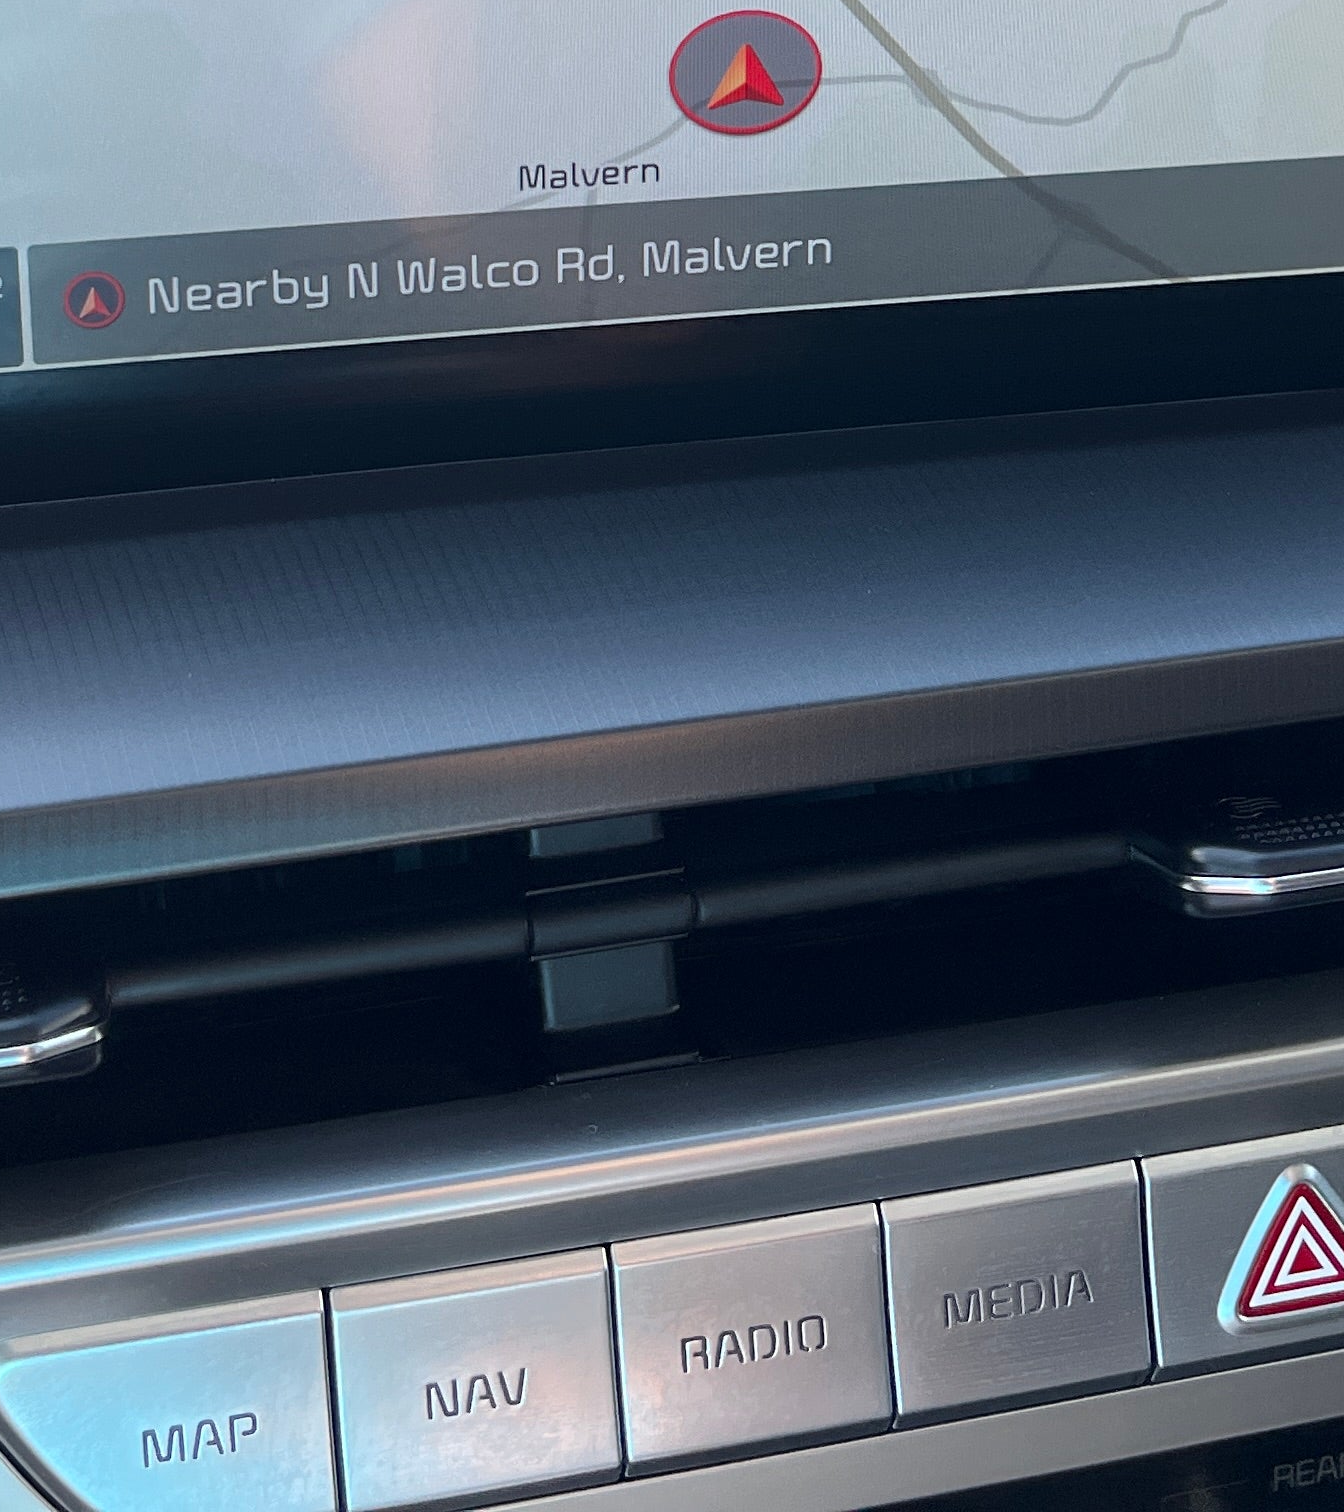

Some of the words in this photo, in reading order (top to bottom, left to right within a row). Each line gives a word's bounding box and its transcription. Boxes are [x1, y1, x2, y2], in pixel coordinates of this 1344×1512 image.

[519, 162, 660, 192] Malvern
[147, 268, 330, 315] Nearby
[347, 261, 379, 300] N
[396, 253, 541, 296] Walco
[556, 243, 625, 285] Rd,
[642, 236, 833, 278] Malvern
[943, 1268, 1096, 1331] MEDIA
[679, 1313, 828, 1374] RADIO
[424, 1367, 528, 1421] NAV
[141, 1411, 259, 1469] MAP
